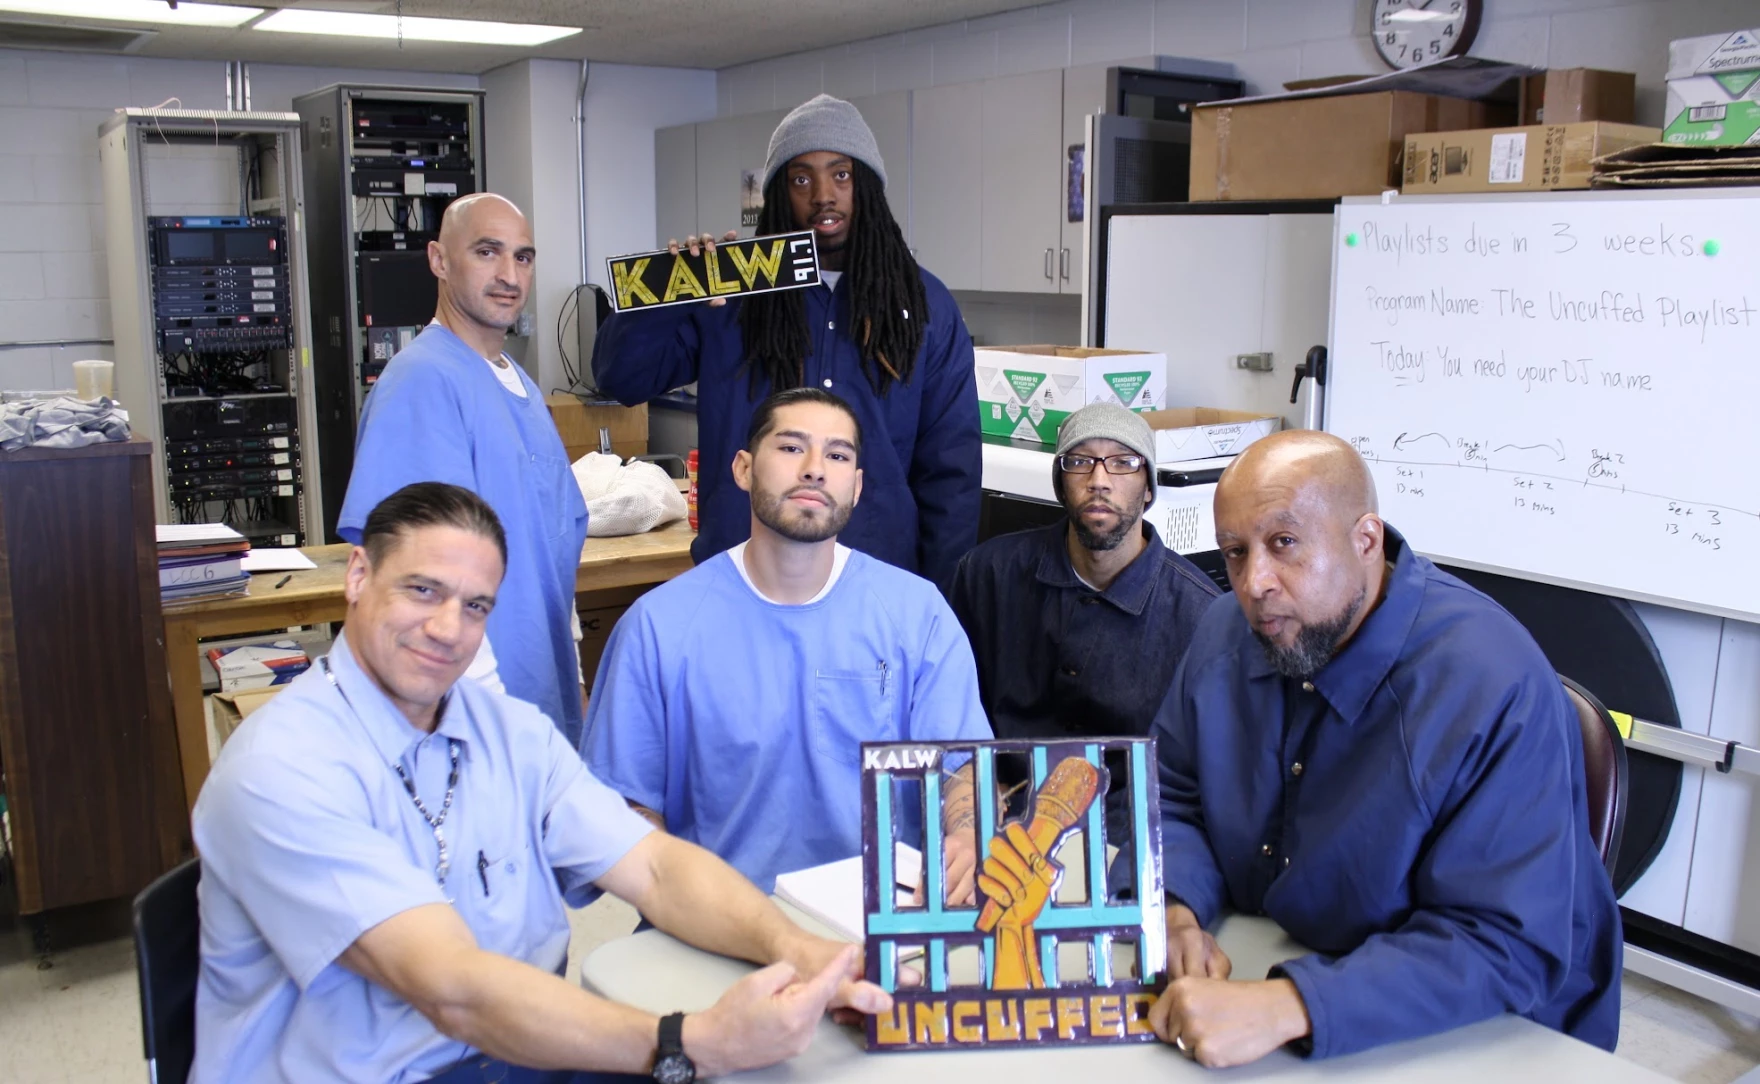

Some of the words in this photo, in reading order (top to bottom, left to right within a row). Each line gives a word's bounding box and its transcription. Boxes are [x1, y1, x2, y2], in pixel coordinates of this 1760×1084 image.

[1443, 23, 1454, 37] 4
[1386, 32, 1396, 45] 8
[1399, 44, 1408, 58] 7
[1429, 40, 1440, 55] 5
[1412, 48, 1423, 62] 6
[1430, 148, 1439, 185] acer
[742, 213, 759, 225] 2013
[1362, 220, 1449, 268] Playlists
[1464, 221, 1501, 257] due
[1511, 231, 1528, 253] in
[1551, 222, 1578, 254] 3
[612, 239, 787, 310] KALW
[1365, 285, 1426, 326] Program
[1491, 288, 1536, 318] The
[1549, 290, 1645, 323] Uncuffed
[1656, 296, 1758, 344] Playlist
[1437, 345, 1463, 378] You
[1474, 350, 1507, 378] need
[1517, 364, 1556, 393] your
[1562, 358, 1593, 386] DJ
[1601, 370, 1652, 391] name
[1011, 374, 1032, 383] STANDARD
[1112, 376, 1137, 384] STANDARD
[1615, 453, 1625, 464] 2
[1396, 466, 1414, 477] Set
[1513, 476, 1534, 490] Set
[1543, 482, 1554, 490] 2
[1514, 497, 1526, 507] 13
[1668, 501, 1693, 516] Set
[1707, 509, 1721, 525] 3
[1665, 523, 1679, 535] 13
[203, 564, 214, 580] 6
[864, 749, 938, 770] KALW
[876, 993, 1159, 1045] UNCUFFED
